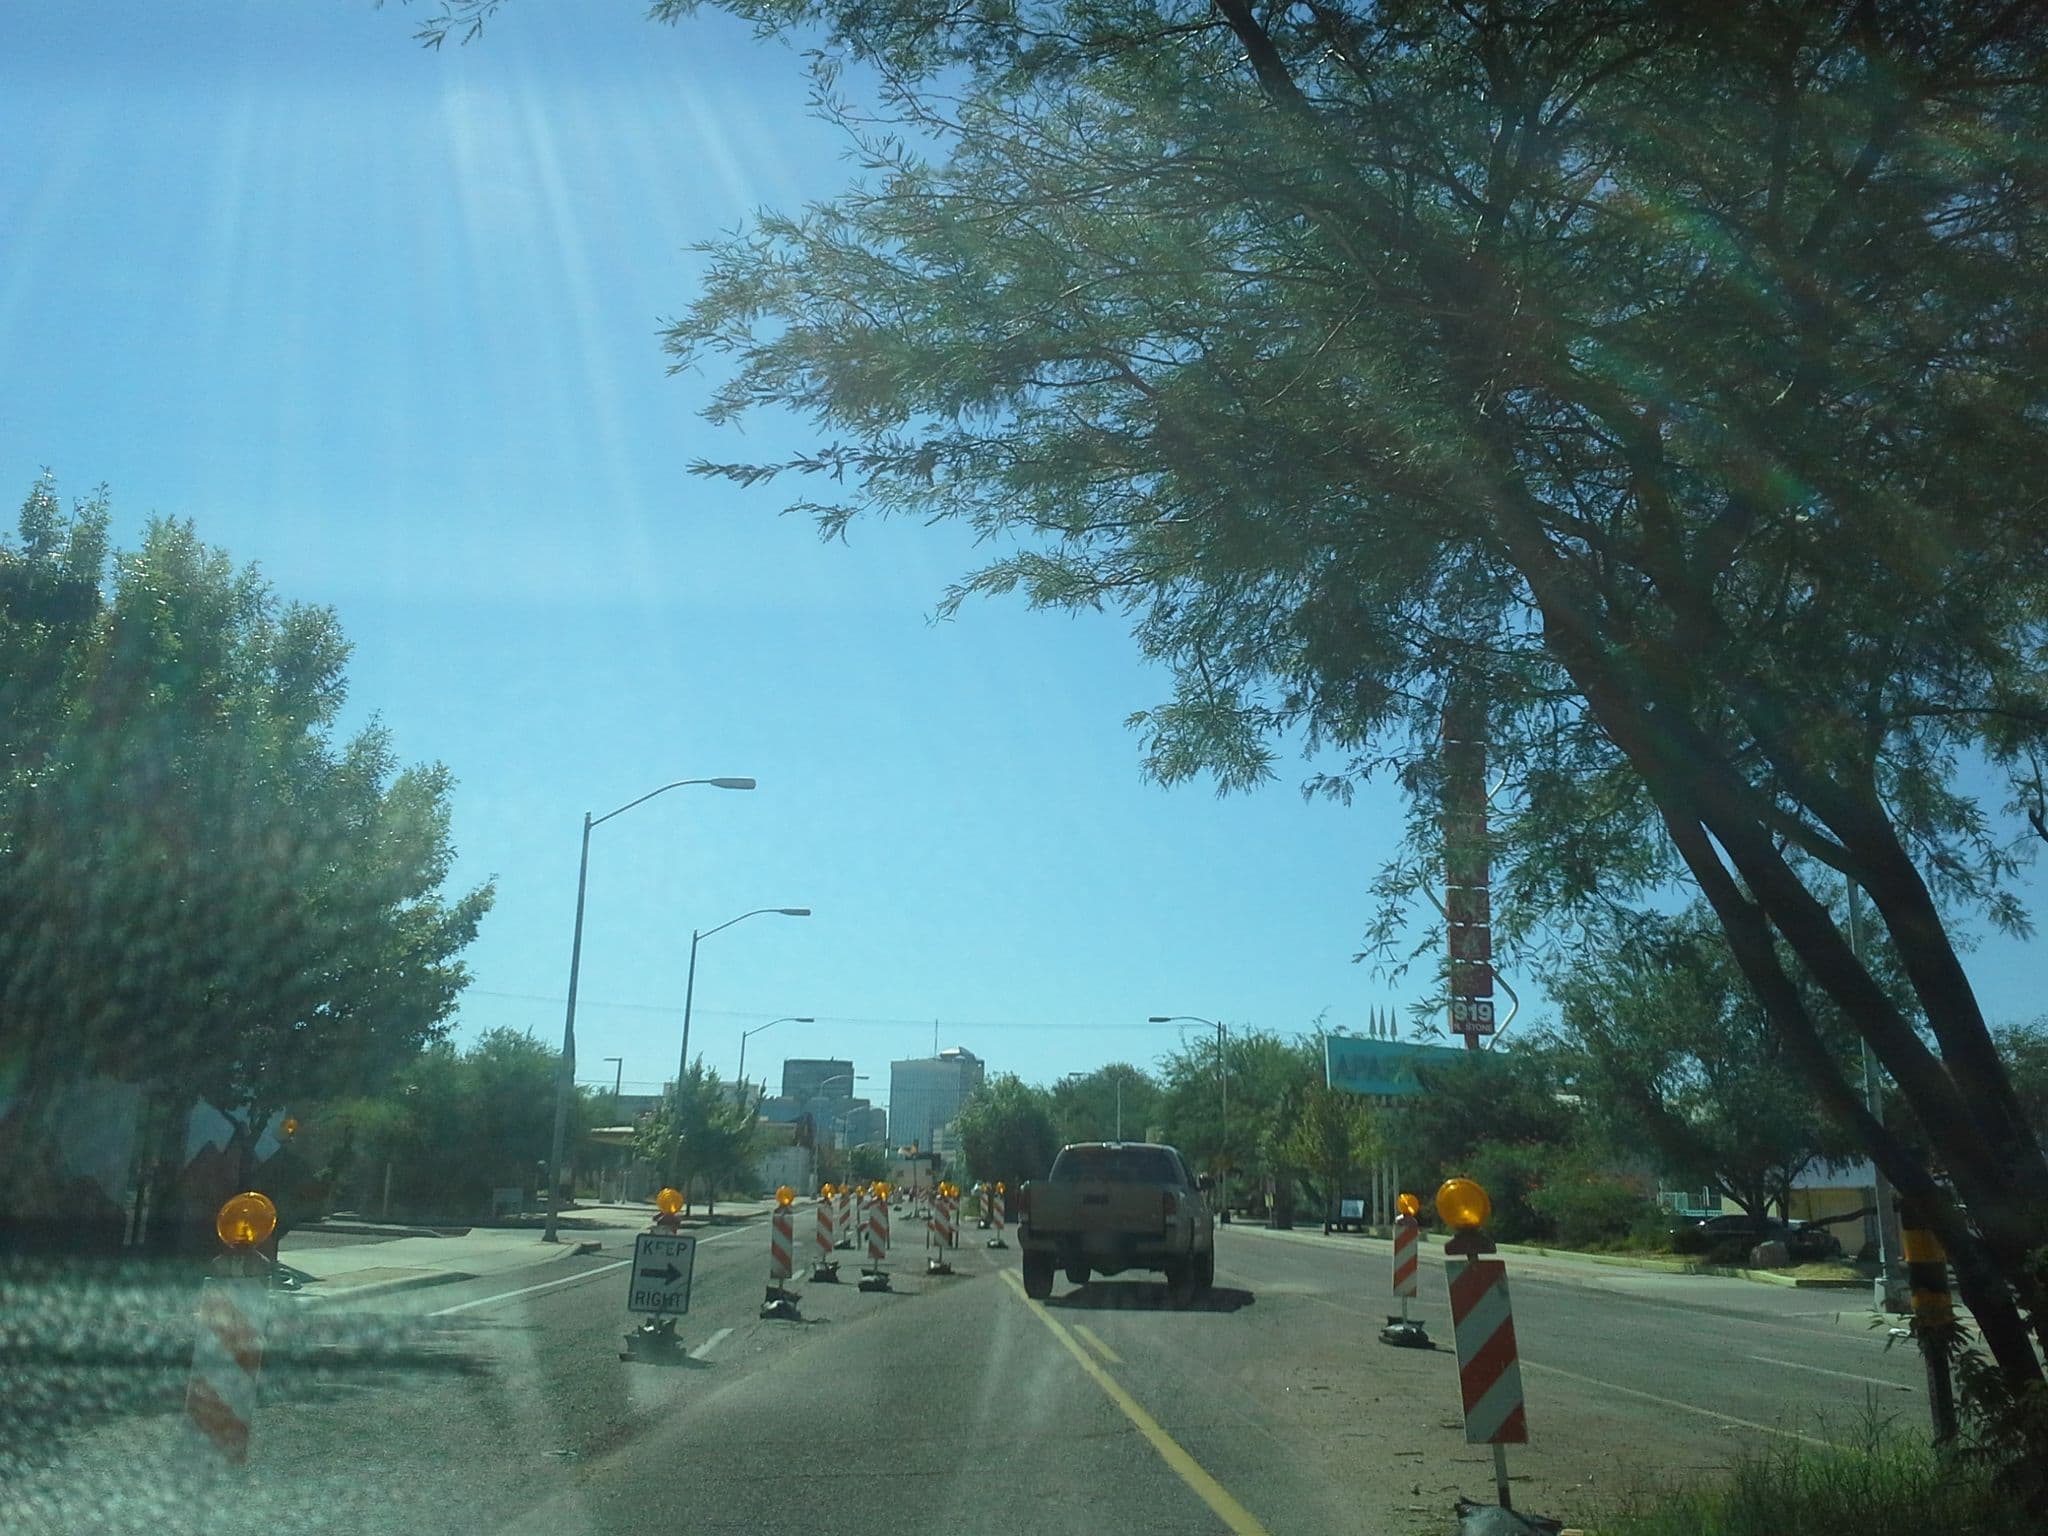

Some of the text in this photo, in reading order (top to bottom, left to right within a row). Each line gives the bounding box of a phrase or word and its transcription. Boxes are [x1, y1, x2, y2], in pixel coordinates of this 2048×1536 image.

[1453, 1003, 1493, 1022] 919
[643, 1240, 688, 1257] KEEP
[635, 1290, 683, 1308] RIGHT
